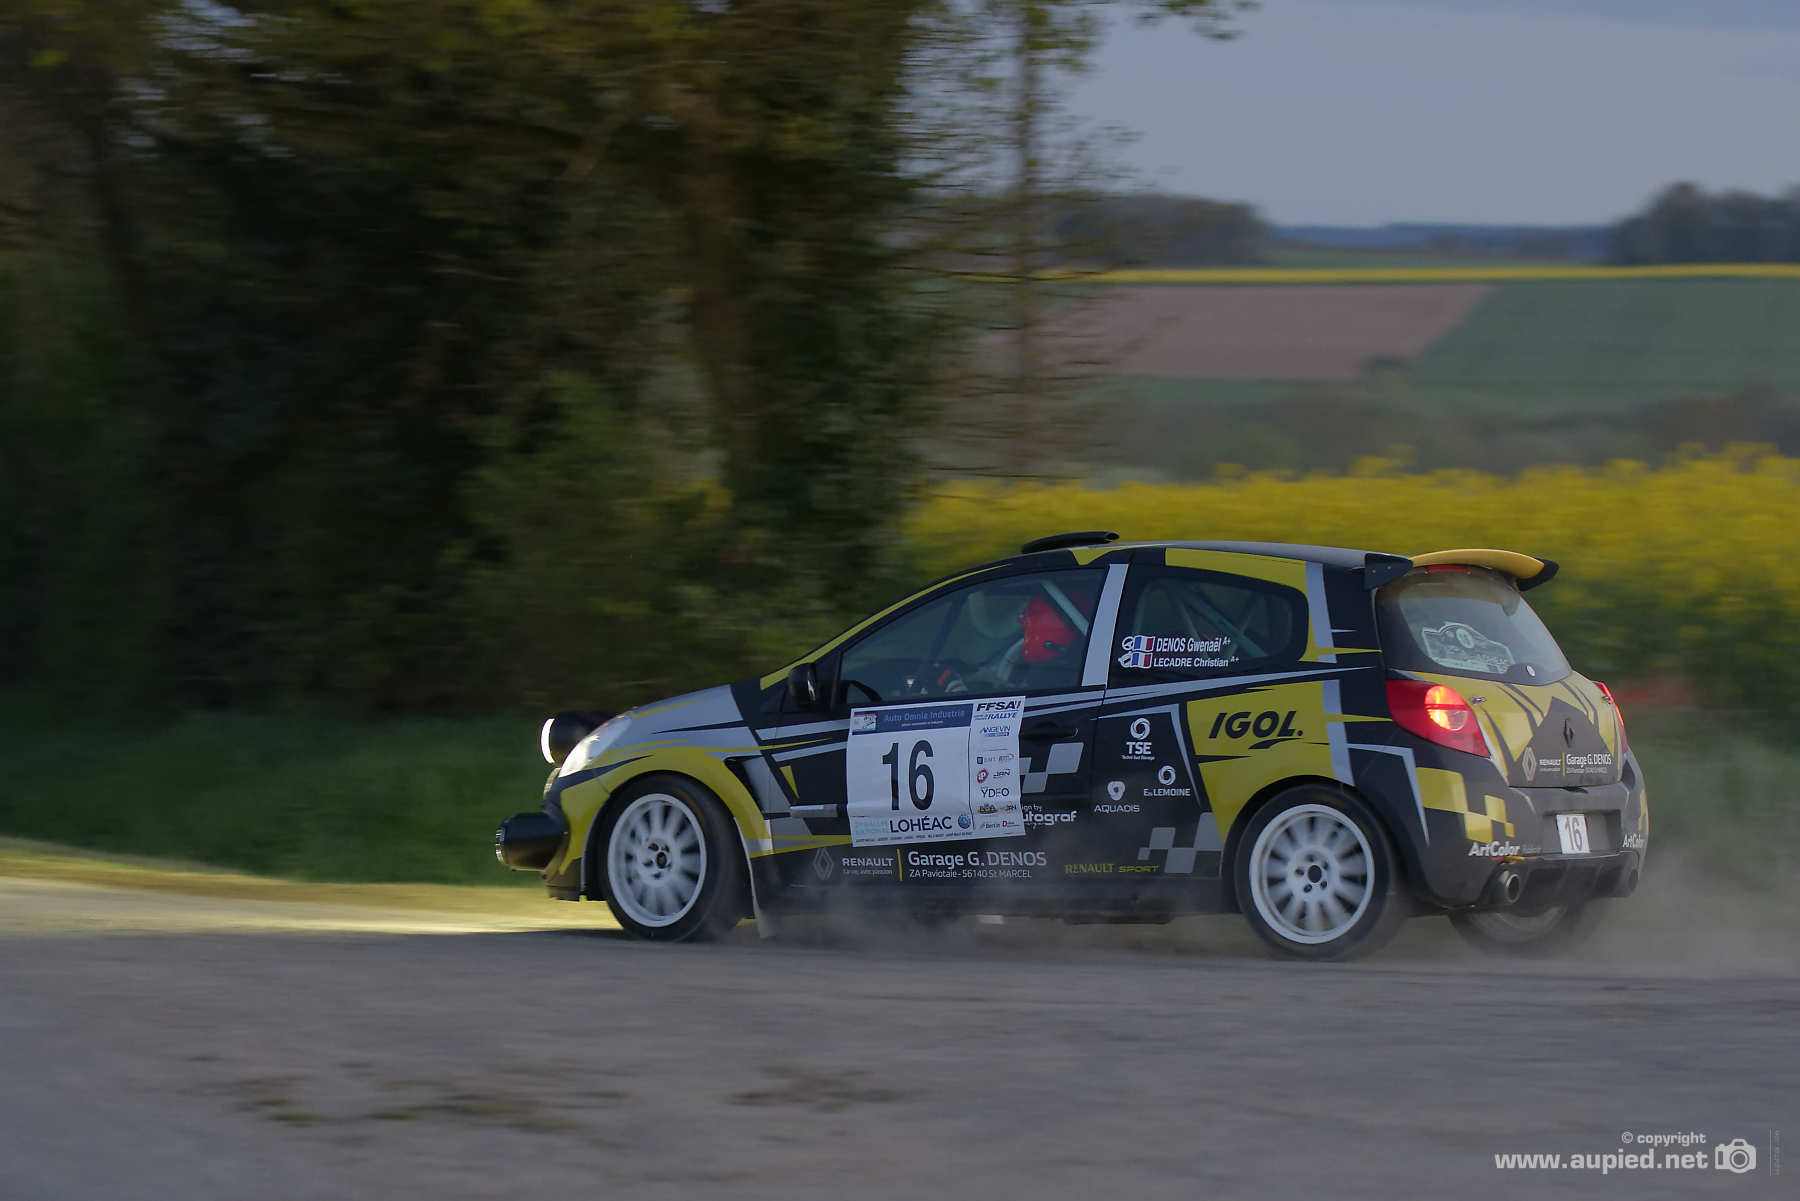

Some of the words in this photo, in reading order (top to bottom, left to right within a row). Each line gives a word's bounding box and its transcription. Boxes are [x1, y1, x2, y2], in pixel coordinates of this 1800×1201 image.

[1155, 638, 1186, 652] DENOS
[1187, 637, 1222, 652] Gwenaël
[1153, 657, 1192, 668] LECADRE
[1193, 656, 1229, 668] Christian
[987, 711, 1017, 720] RALLYE
[1126, 741, 1153, 755] TSE
[1566, 753, 1587, 768] Garage
[1594, 753, 1613, 766] DENOS
[881, 739, 936, 811] 16
[1094, 804, 1140, 814] AQUADIS
[889, 815, 953, 833] LOHÉAC
[1022, 810, 1078, 826] utograf
[1564, 816, 1583, 852] 16
[1467, 840, 1520, 857] ArtColor
[841, 857, 894, 867] RENAULT
[908, 851, 964, 869] Garage
[967, 851, 985, 866] G.
[986, 851, 1047, 866] DENOS
[909, 869, 921, 878] ZA
[999, 869, 1033, 878] MARCEL
[1064, 863, 1115, 875] RENAULT
[1118, 865, 1160, 873] SPORT
